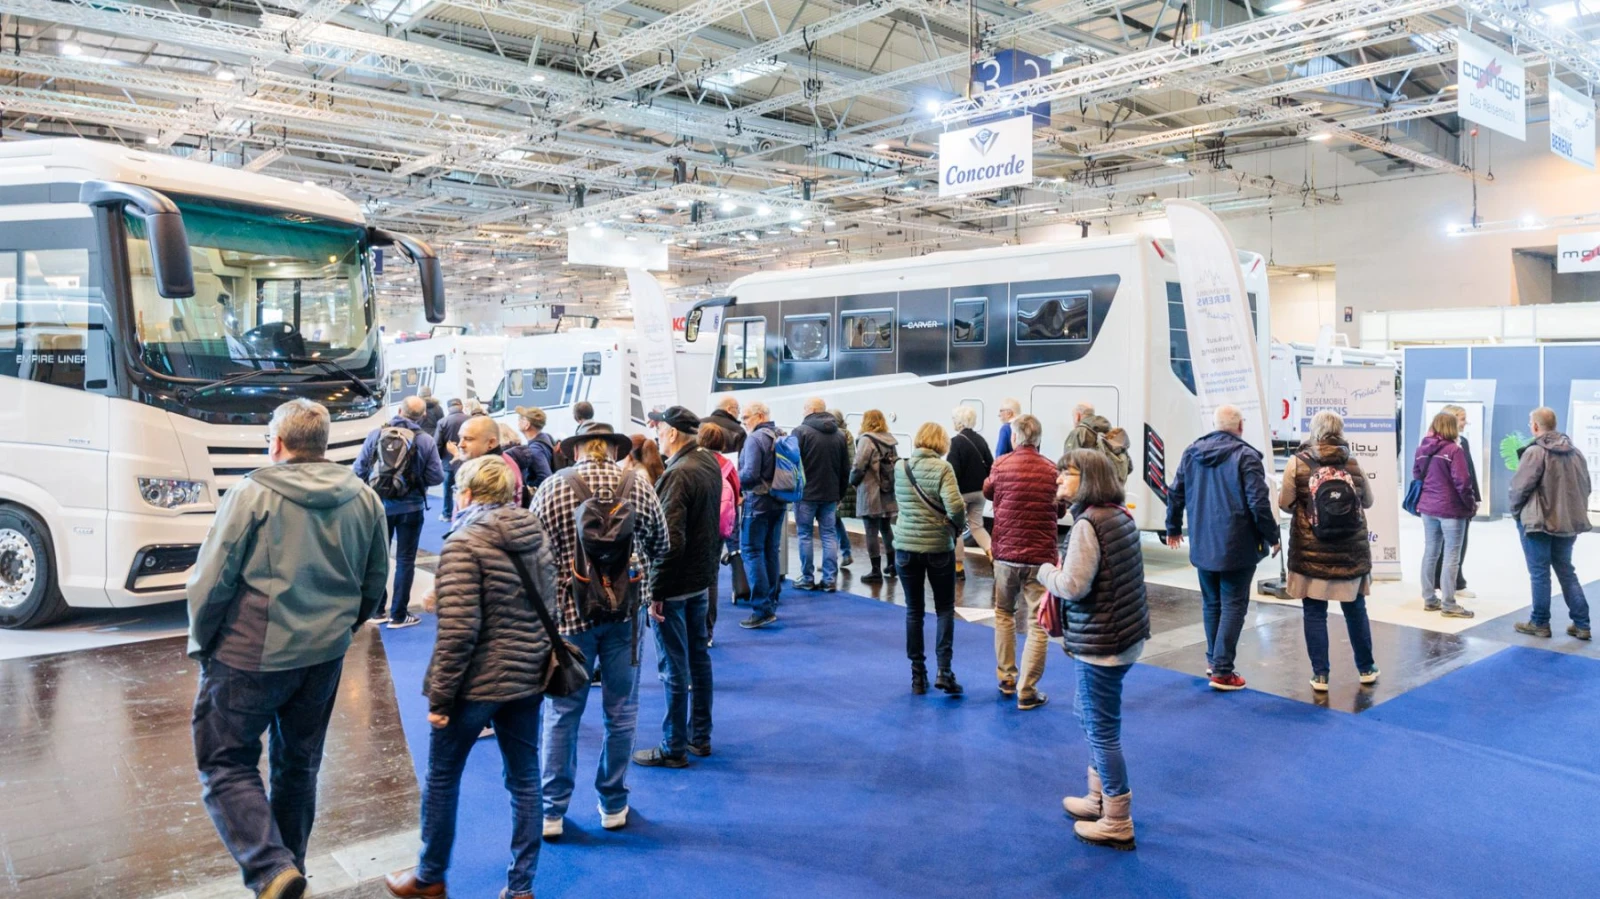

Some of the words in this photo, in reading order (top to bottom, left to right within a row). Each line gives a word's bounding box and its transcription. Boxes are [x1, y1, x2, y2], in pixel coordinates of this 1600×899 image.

[946, 154, 1025, 186] Concorde
[16, 354, 54, 364] EMPIRE
[58, 354, 87, 364] LINER
[1306, 406, 1348, 416] BENS
[1351, 442, 1378, 452] ibu
